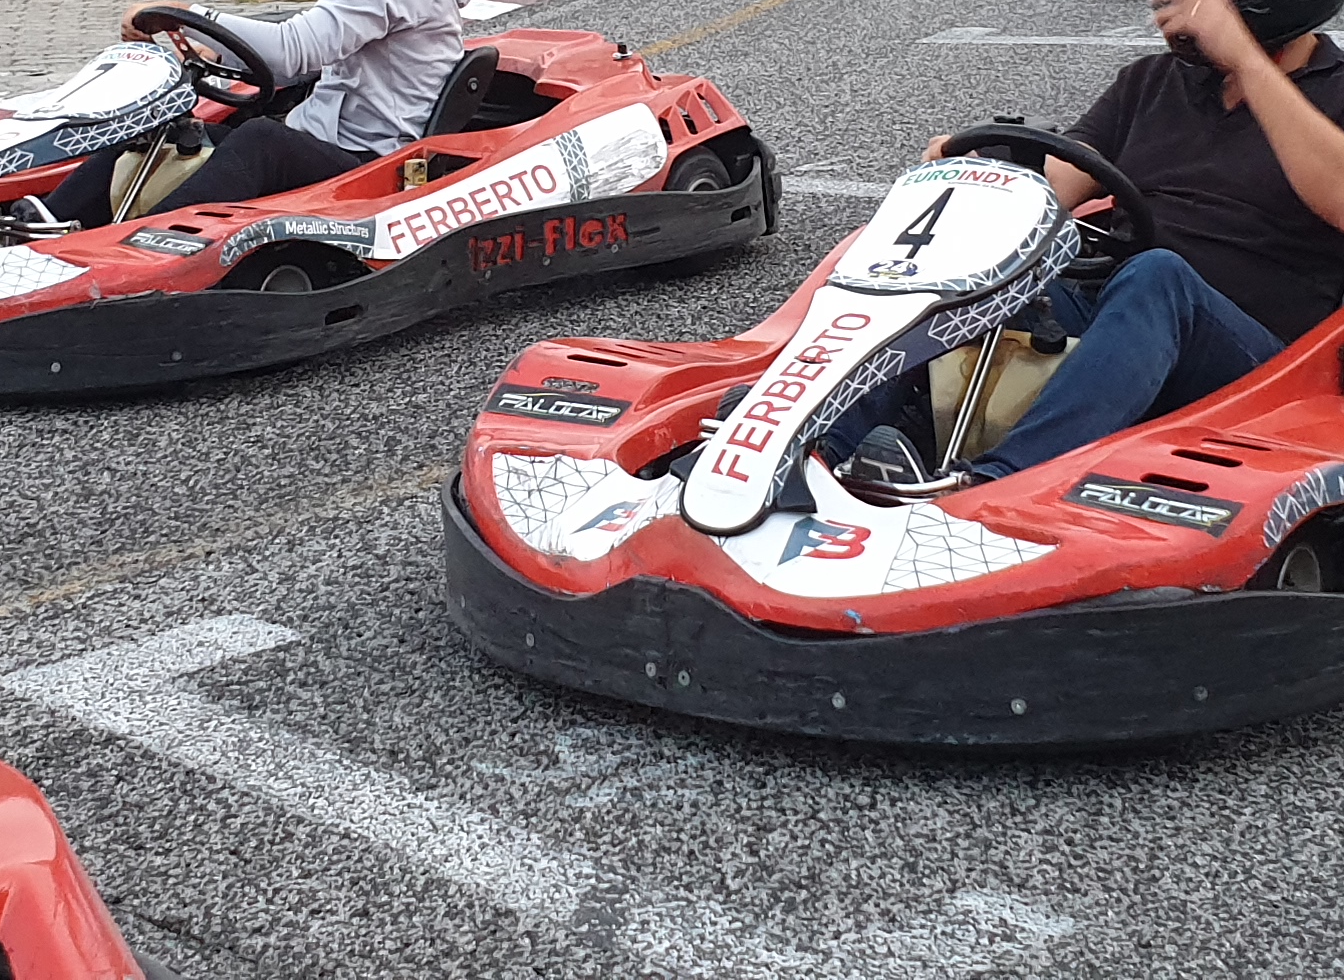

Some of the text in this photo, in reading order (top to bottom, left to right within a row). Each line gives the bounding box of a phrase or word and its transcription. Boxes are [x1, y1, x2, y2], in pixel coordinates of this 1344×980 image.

[902, 169, 1019, 187] EUROINDY
[285, 220, 329, 235] Metallic
[387, 164, 557, 255] FERBERTO
[893, 187, 955, 260] 4
[498, 393, 622, 423] PALOCAR
[709, 311, 872, 484] FERBERTO
[1080, 483, 1232, 525] PALOCAR
